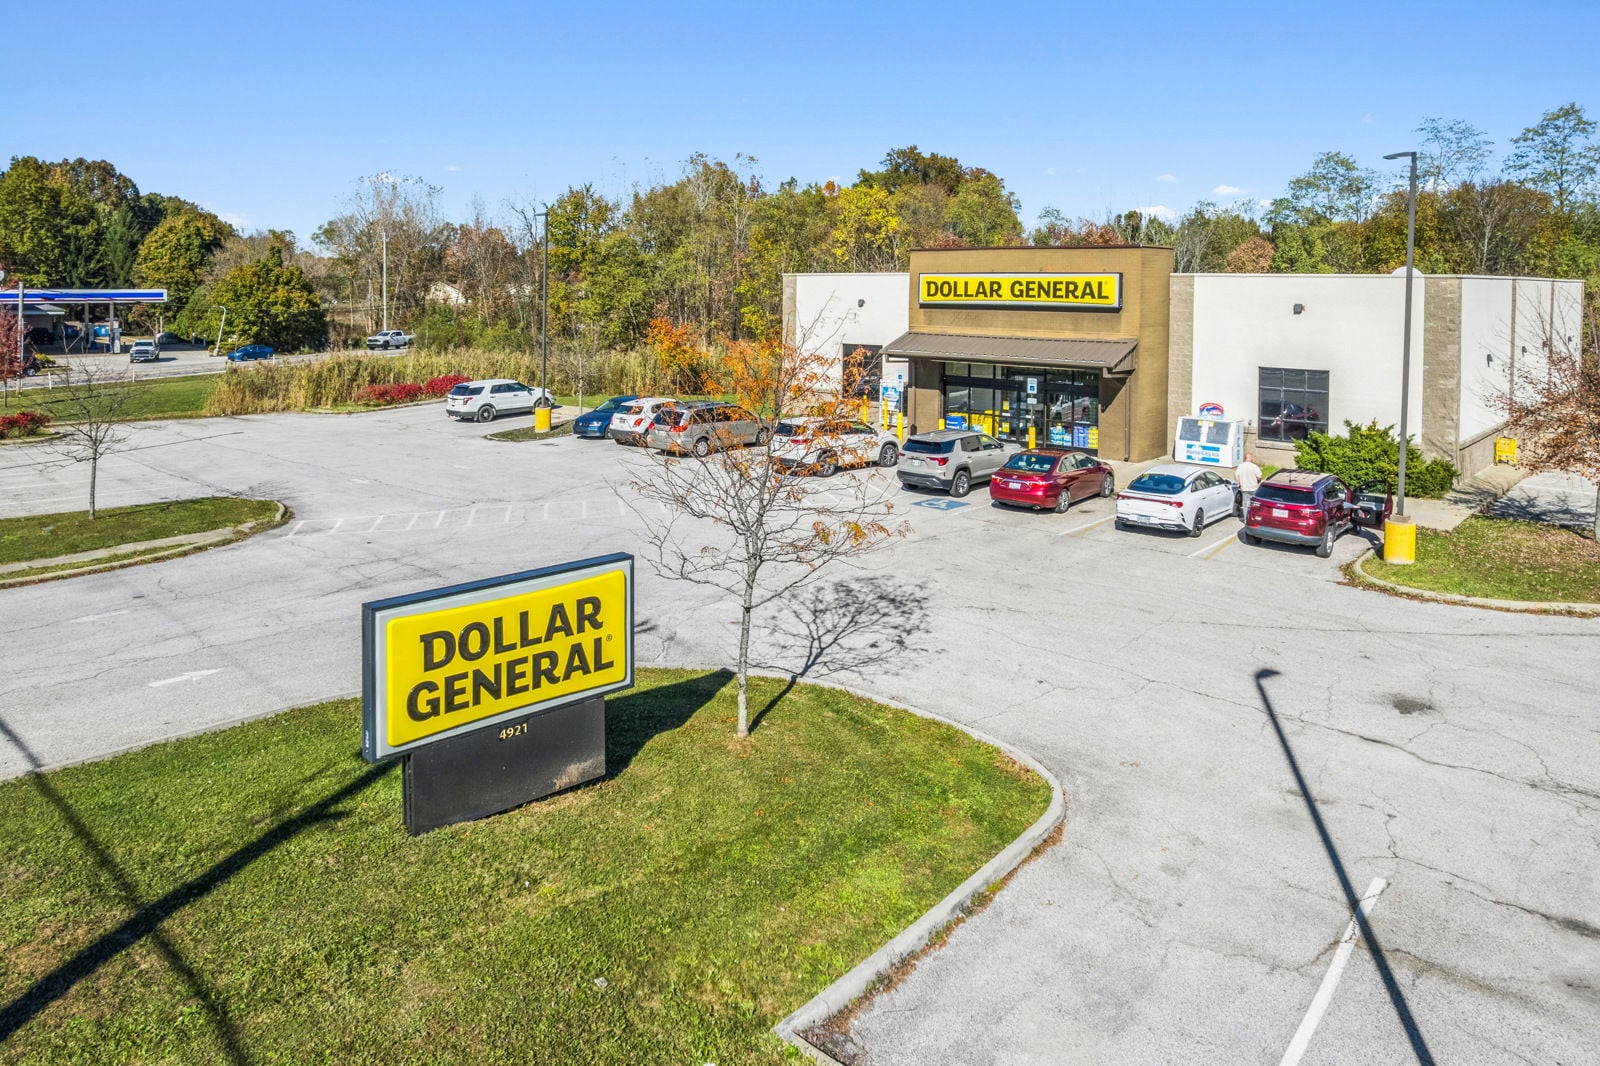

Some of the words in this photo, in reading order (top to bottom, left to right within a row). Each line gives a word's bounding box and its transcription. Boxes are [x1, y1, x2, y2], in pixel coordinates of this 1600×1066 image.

[925, 280, 1003, 298] DOLLAR
[1010, 280, 1109, 300] GENERAL
[419, 596, 604, 673] DOLLAR
[406, 633, 615, 723] GENERAL
[499, 723, 528, 740] 4921
